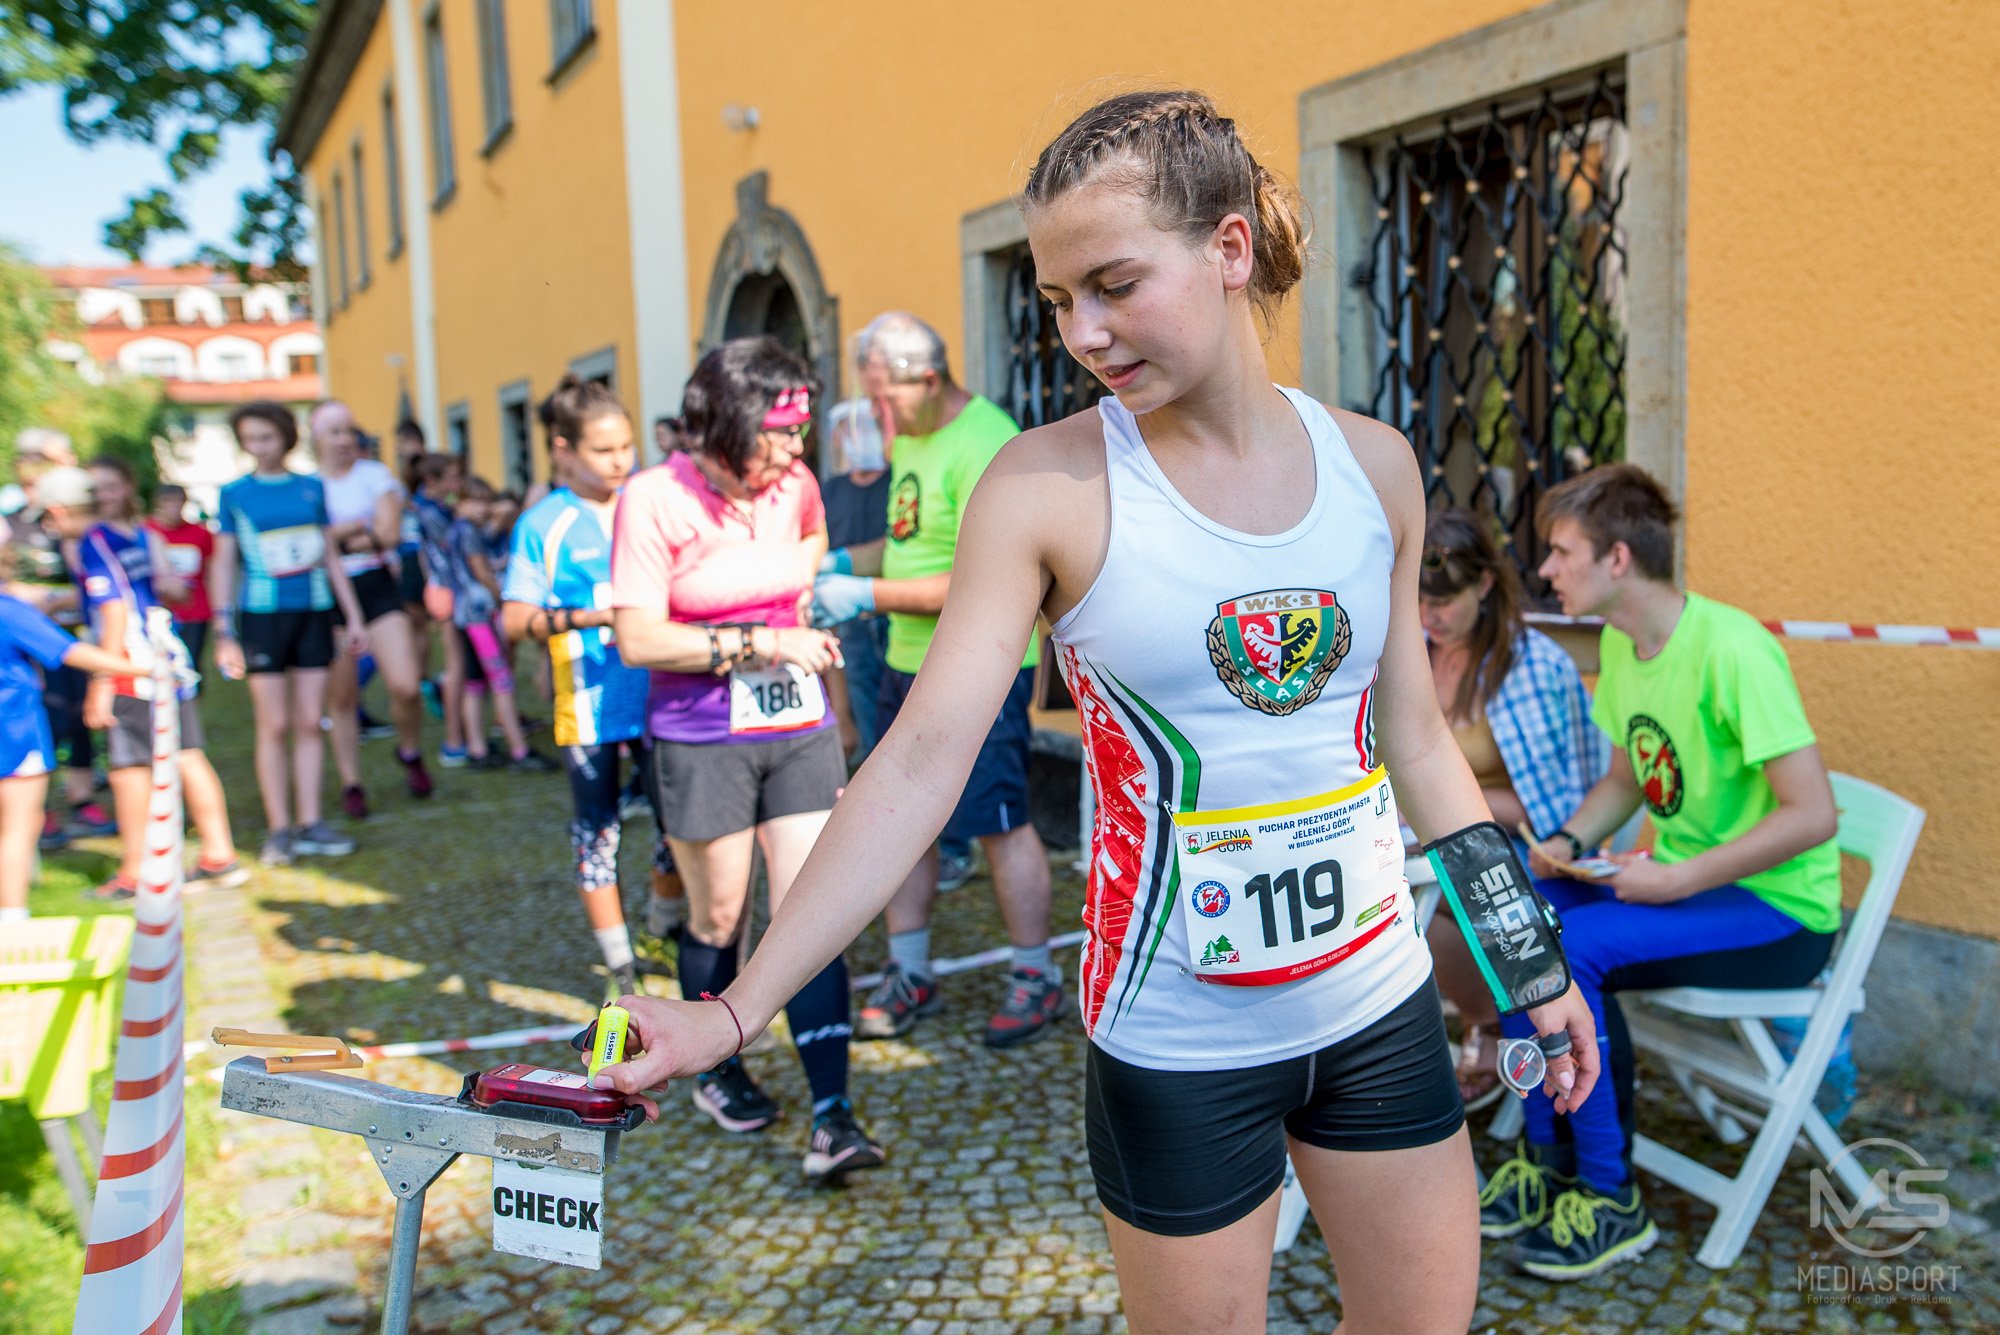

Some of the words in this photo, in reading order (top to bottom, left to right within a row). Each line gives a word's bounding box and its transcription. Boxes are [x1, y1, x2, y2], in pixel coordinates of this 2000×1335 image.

[1258, 820, 1296, 834] PUCHAR
[1297, 807, 1348, 828] PREZYDENTA
[1348, 796, 1371, 815] MIASTA
[1205, 828, 1251, 843] JELENIA
[1292, 825, 1331, 840] JELENIEJ
[1332, 816, 1351, 830] GÓRY
[1218, 840, 1252, 853] GÓRA
[1296, 839, 1314, 849] BIEGU
[1244, 859, 1344, 948] 119
[1289, 963, 1313, 976] JELENIA
[493, 1186, 600, 1233] CHECK
